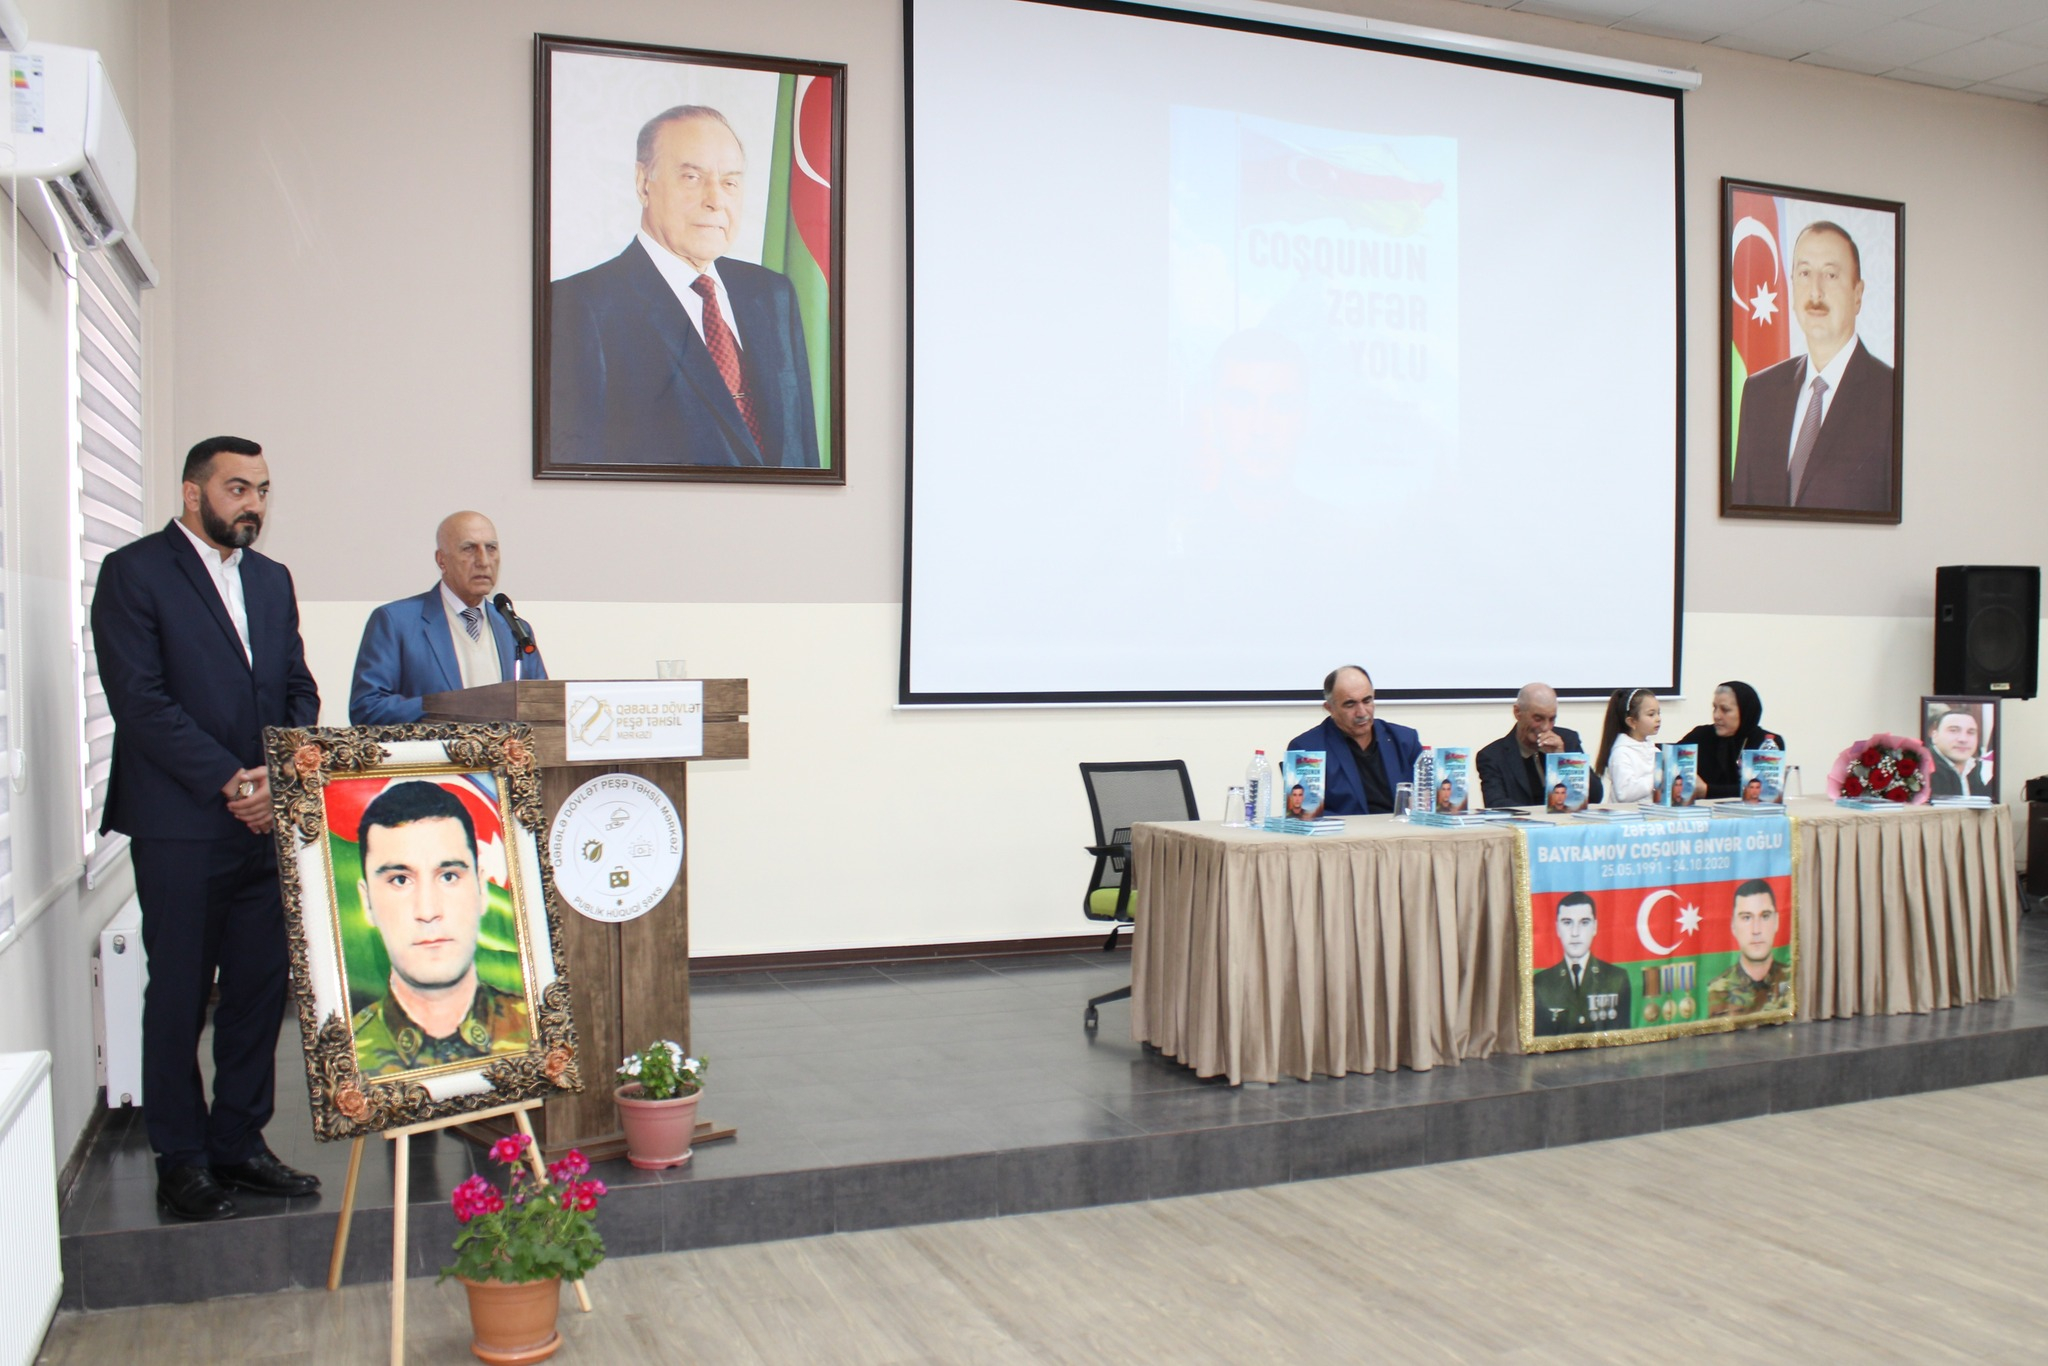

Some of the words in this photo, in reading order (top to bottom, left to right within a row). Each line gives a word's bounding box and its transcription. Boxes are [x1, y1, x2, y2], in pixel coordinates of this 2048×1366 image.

[1248, 228, 1428, 283] COŞQUNUN
[1326, 288, 1428, 333] ZƏFƏR
[1349, 340, 1428, 383] YOLU
[616, 704, 659, 715] QƏBƏLƏ
[662, 701, 702, 714] DÖVLƏT
[616, 716, 644, 730] PEŞƏ
[646, 713, 683, 727] TƏHSİL
[553, 819, 568, 868] QƏBƏLƏ
[601, 778, 629, 790] PEŞƏ
[631, 781, 662, 808] TƏHSİL
[1537, 844, 1627, 863] BAYRAMOV
[1630, 839, 1691, 862] COŞQUN
[1694, 836, 1742, 855] ƏNVƏR
[1746, 830, 1783, 851] OĞLU
[1601, 861, 1663, 878] 25.05.1991
[1673, 856, 1731, 872] 24.10.2020
